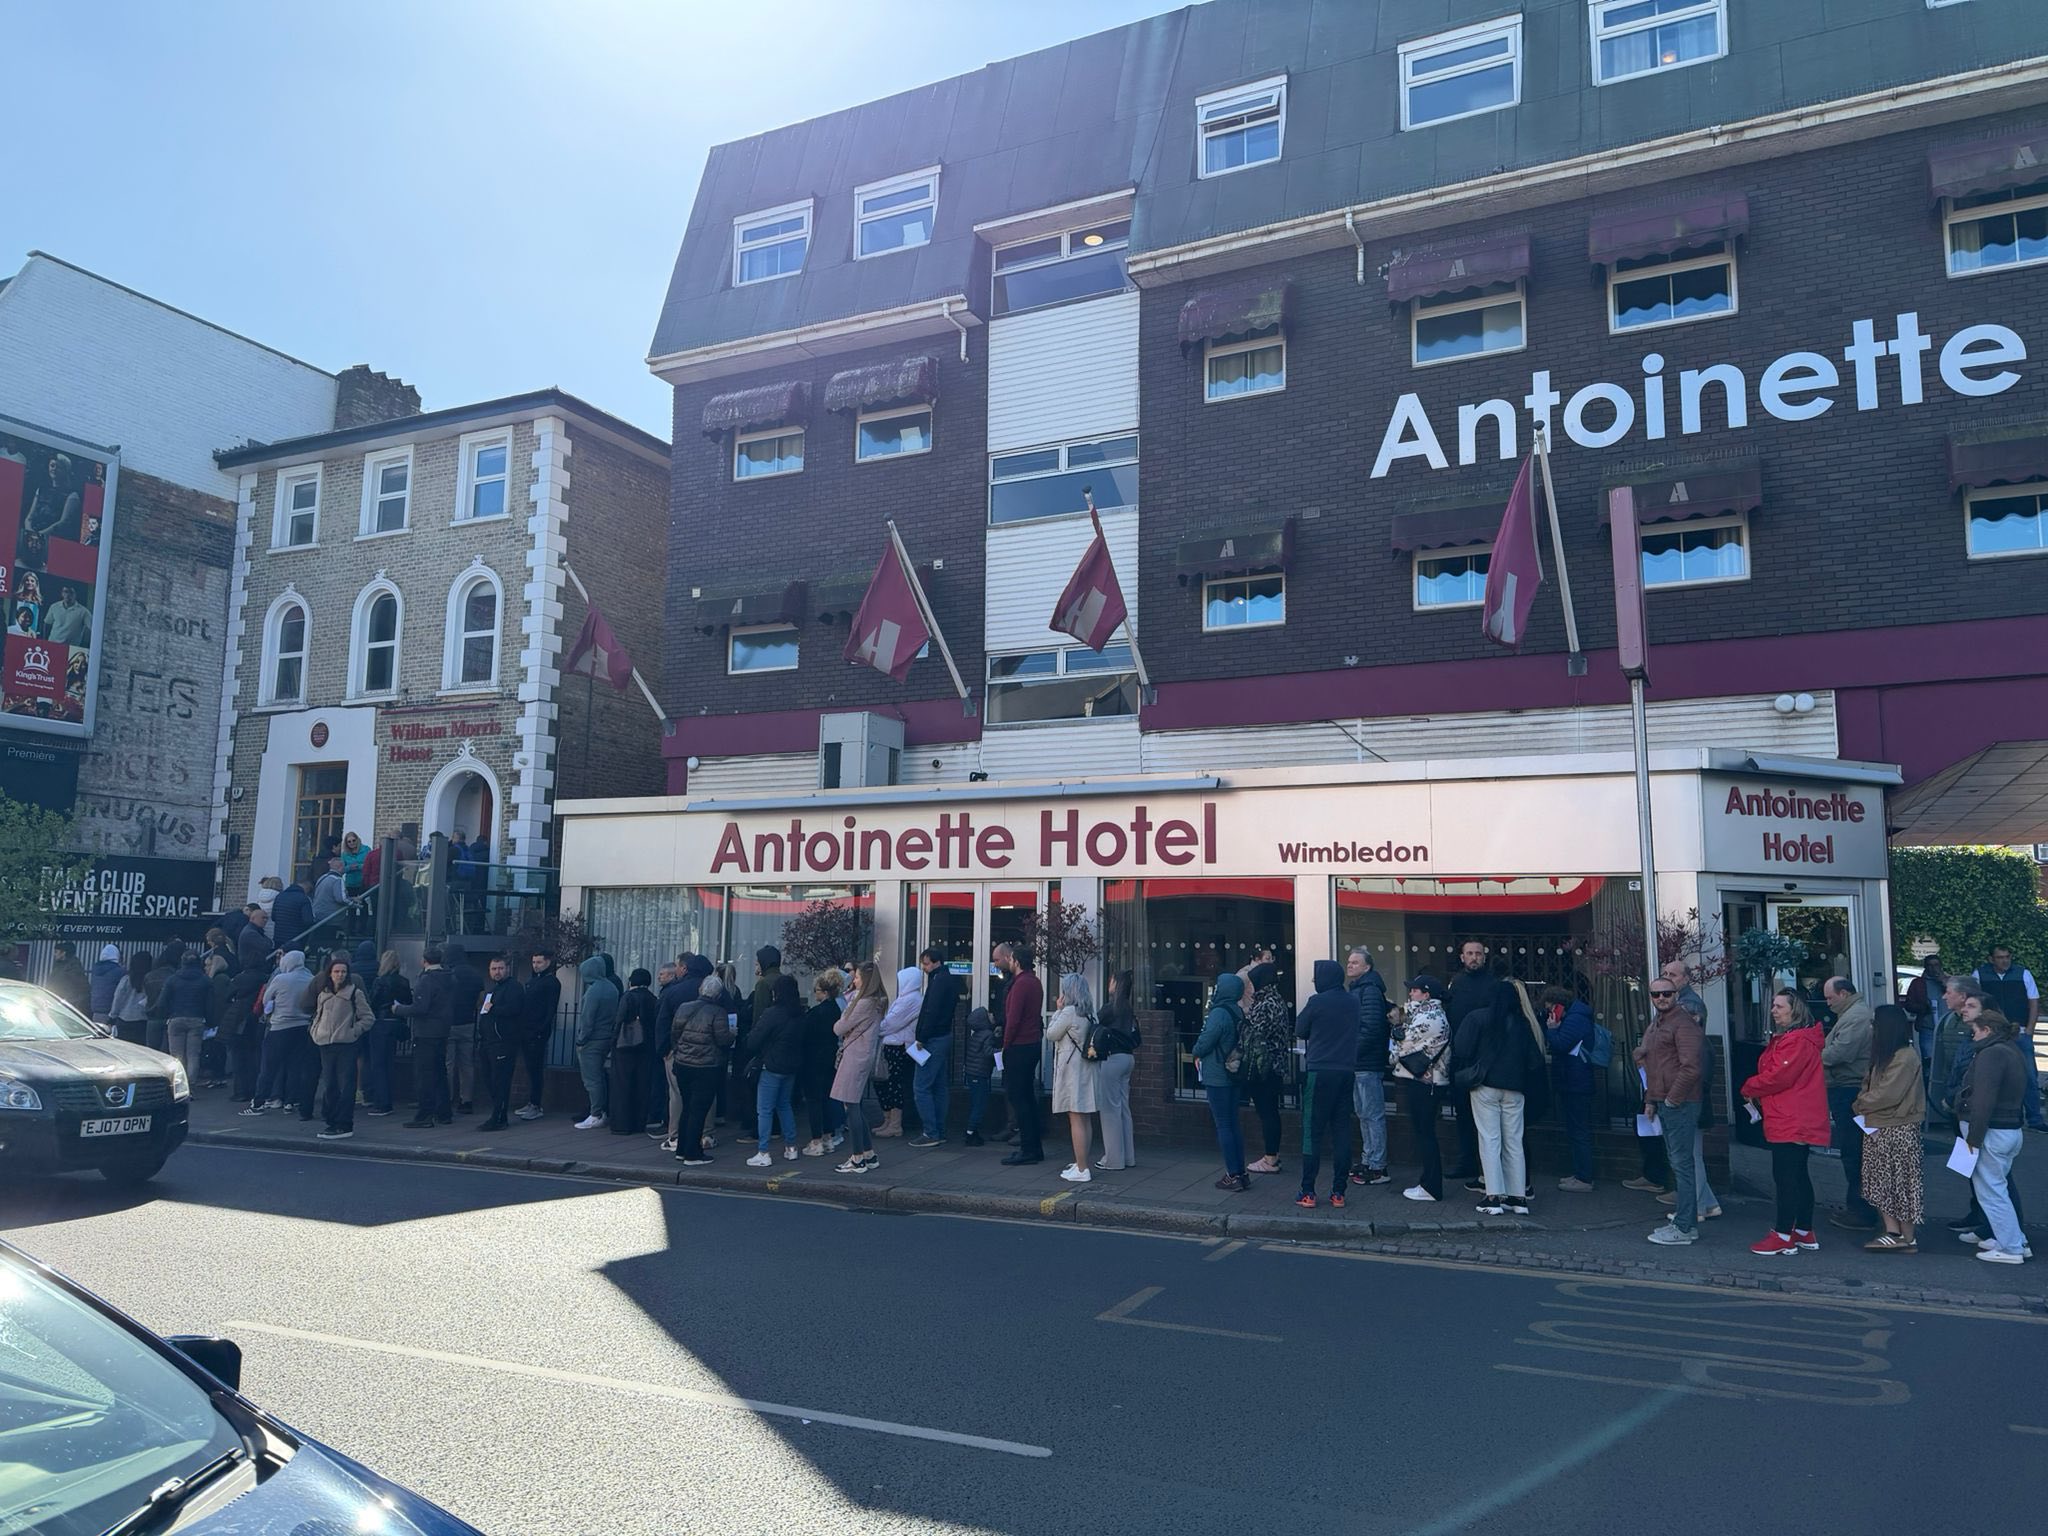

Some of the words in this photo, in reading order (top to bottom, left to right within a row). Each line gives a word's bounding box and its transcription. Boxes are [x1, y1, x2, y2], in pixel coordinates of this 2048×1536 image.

[1370, 312, 2027, 478] Antoinette
[37, 673, 55, 683] Trust
[390, 722, 447, 740] William
[450, 718, 502, 738] Morris
[389, 745, 434, 762] House
[1725, 786, 1865, 823] Antoinette
[710, 812, 1015, 874] Antoinette
[1040, 802, 1217, 867] Hotel
[1763, 832, 1834, 864] Hotel
[1278, 841, 1429, 863] Wimbledon
[83, 869, 96, 892] &
[100, 870, 146, 894] CLUB
[100, 892, 143, 916] HIRE
[144, 895, 199, 918] SPACE
[63, 924, 93, 933] EVERY
[96, 925, 123, 934] WEEK
[86, 1119, 120, 1135] EJ07
[123, 1117, 147, 1133] OPN
